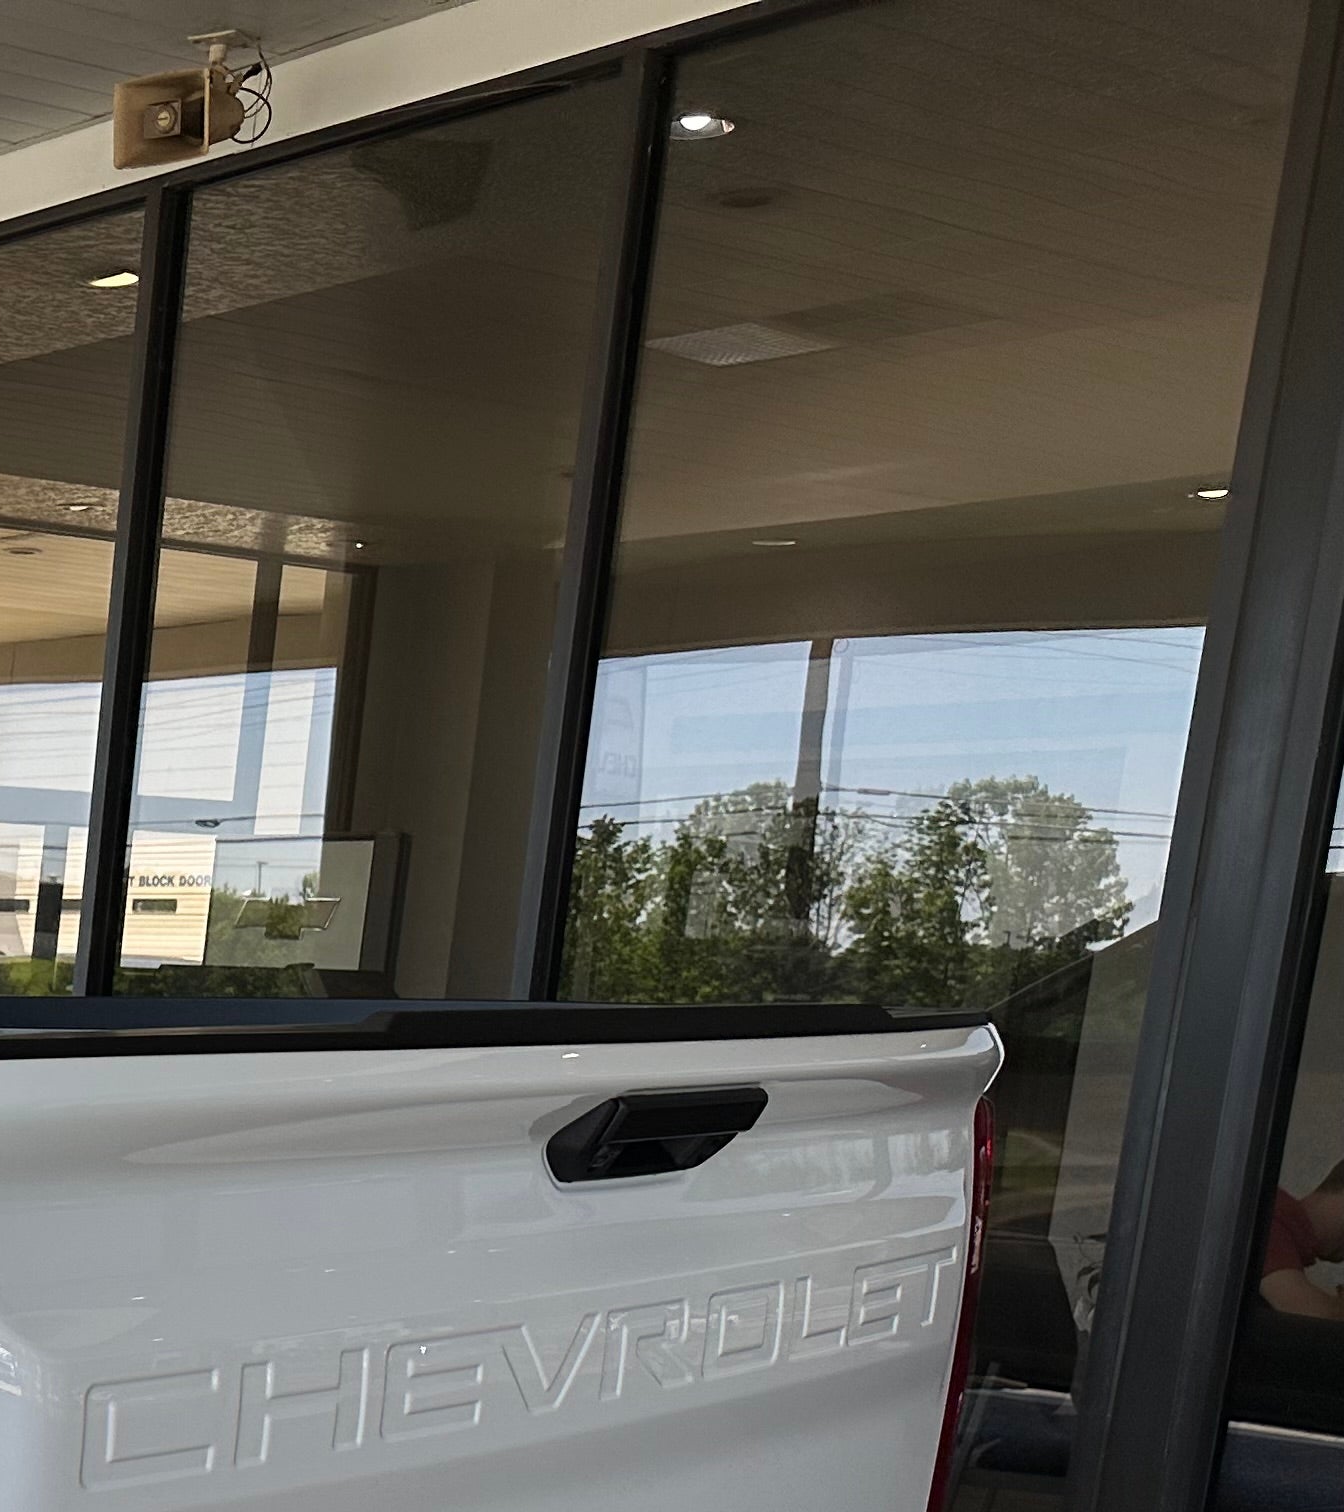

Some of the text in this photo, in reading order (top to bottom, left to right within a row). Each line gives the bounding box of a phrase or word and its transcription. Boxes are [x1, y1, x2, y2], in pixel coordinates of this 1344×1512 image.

[138, 875, 175, 888] BLOCK
[178, 874, 211, 888] DOOR
[79, 1246, 959, 1490] CHEVROLET
